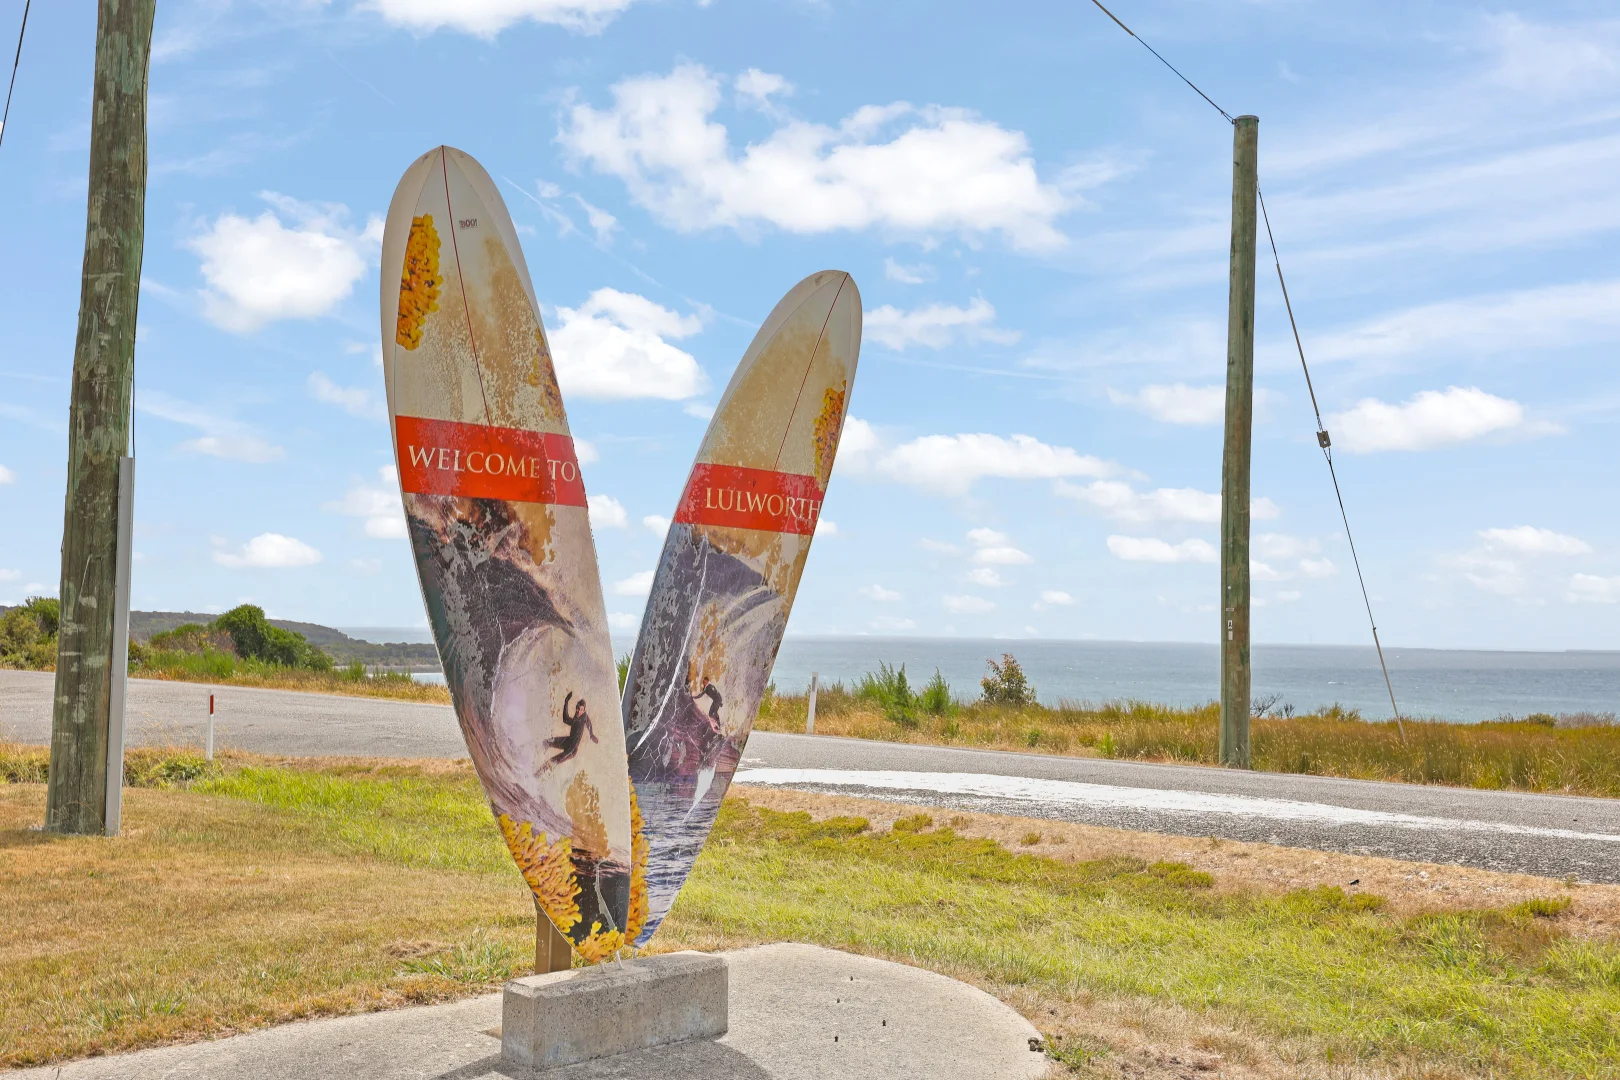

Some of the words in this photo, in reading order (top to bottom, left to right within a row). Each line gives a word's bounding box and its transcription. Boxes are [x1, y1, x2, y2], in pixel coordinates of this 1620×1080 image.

[408, 445, 540, 479] WELCOME
[547, 459, 576, 482] TO
[705, 487, 821, 520] LULWORTH
